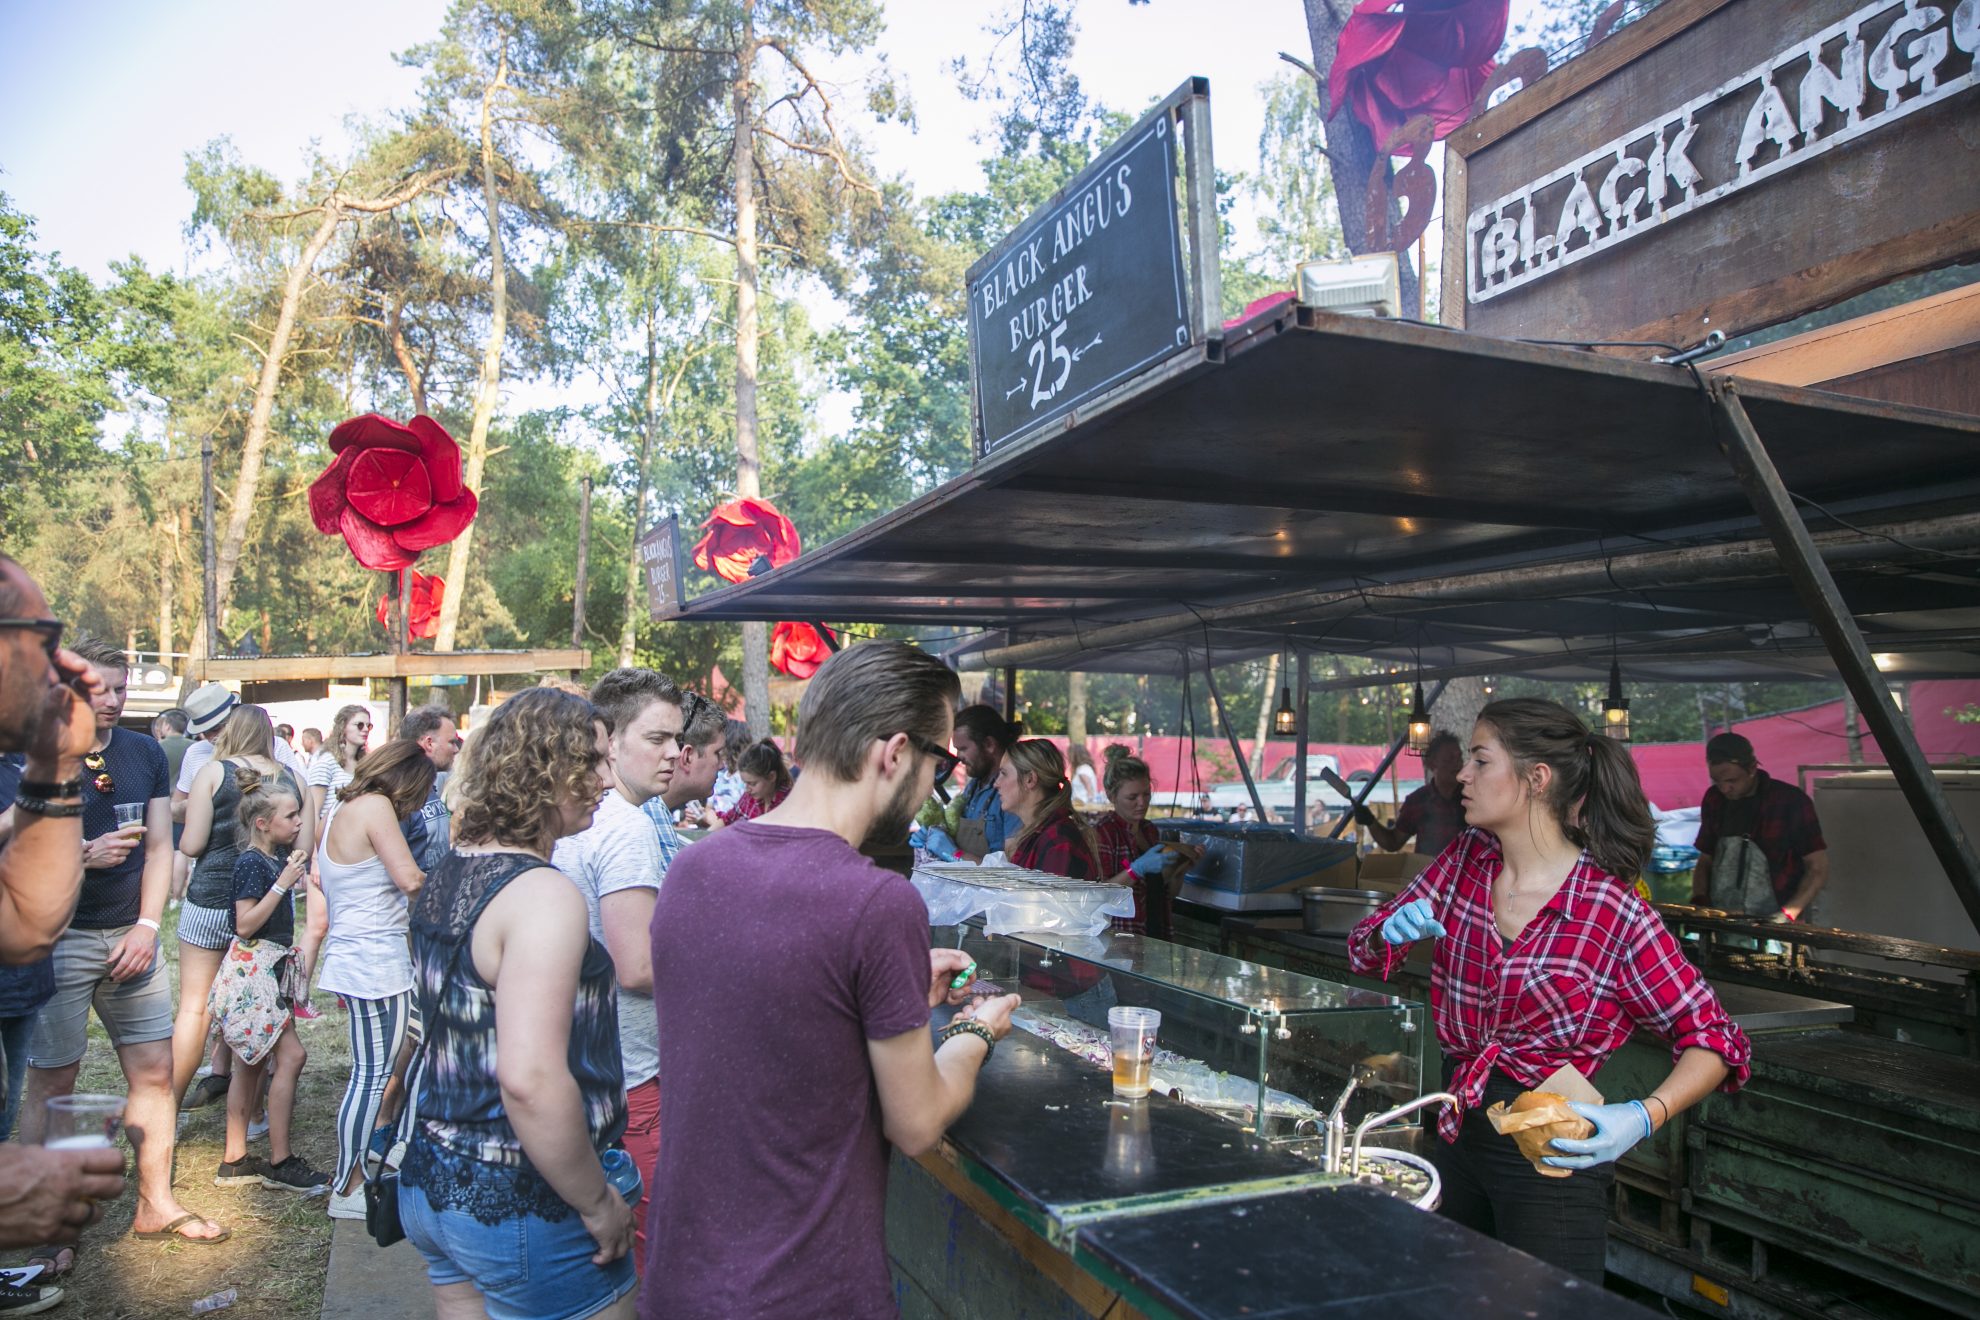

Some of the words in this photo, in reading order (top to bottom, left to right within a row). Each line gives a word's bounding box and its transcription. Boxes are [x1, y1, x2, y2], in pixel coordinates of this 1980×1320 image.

[1481, 118, 1703, 281] BLACK
[1734, 0, 1980, 170] ANG
[982, 237, 1046, 320] BLACK
[1052, 163, 1133, 264] ANGUS
[1008, 264, 1094, 353] BURGER
